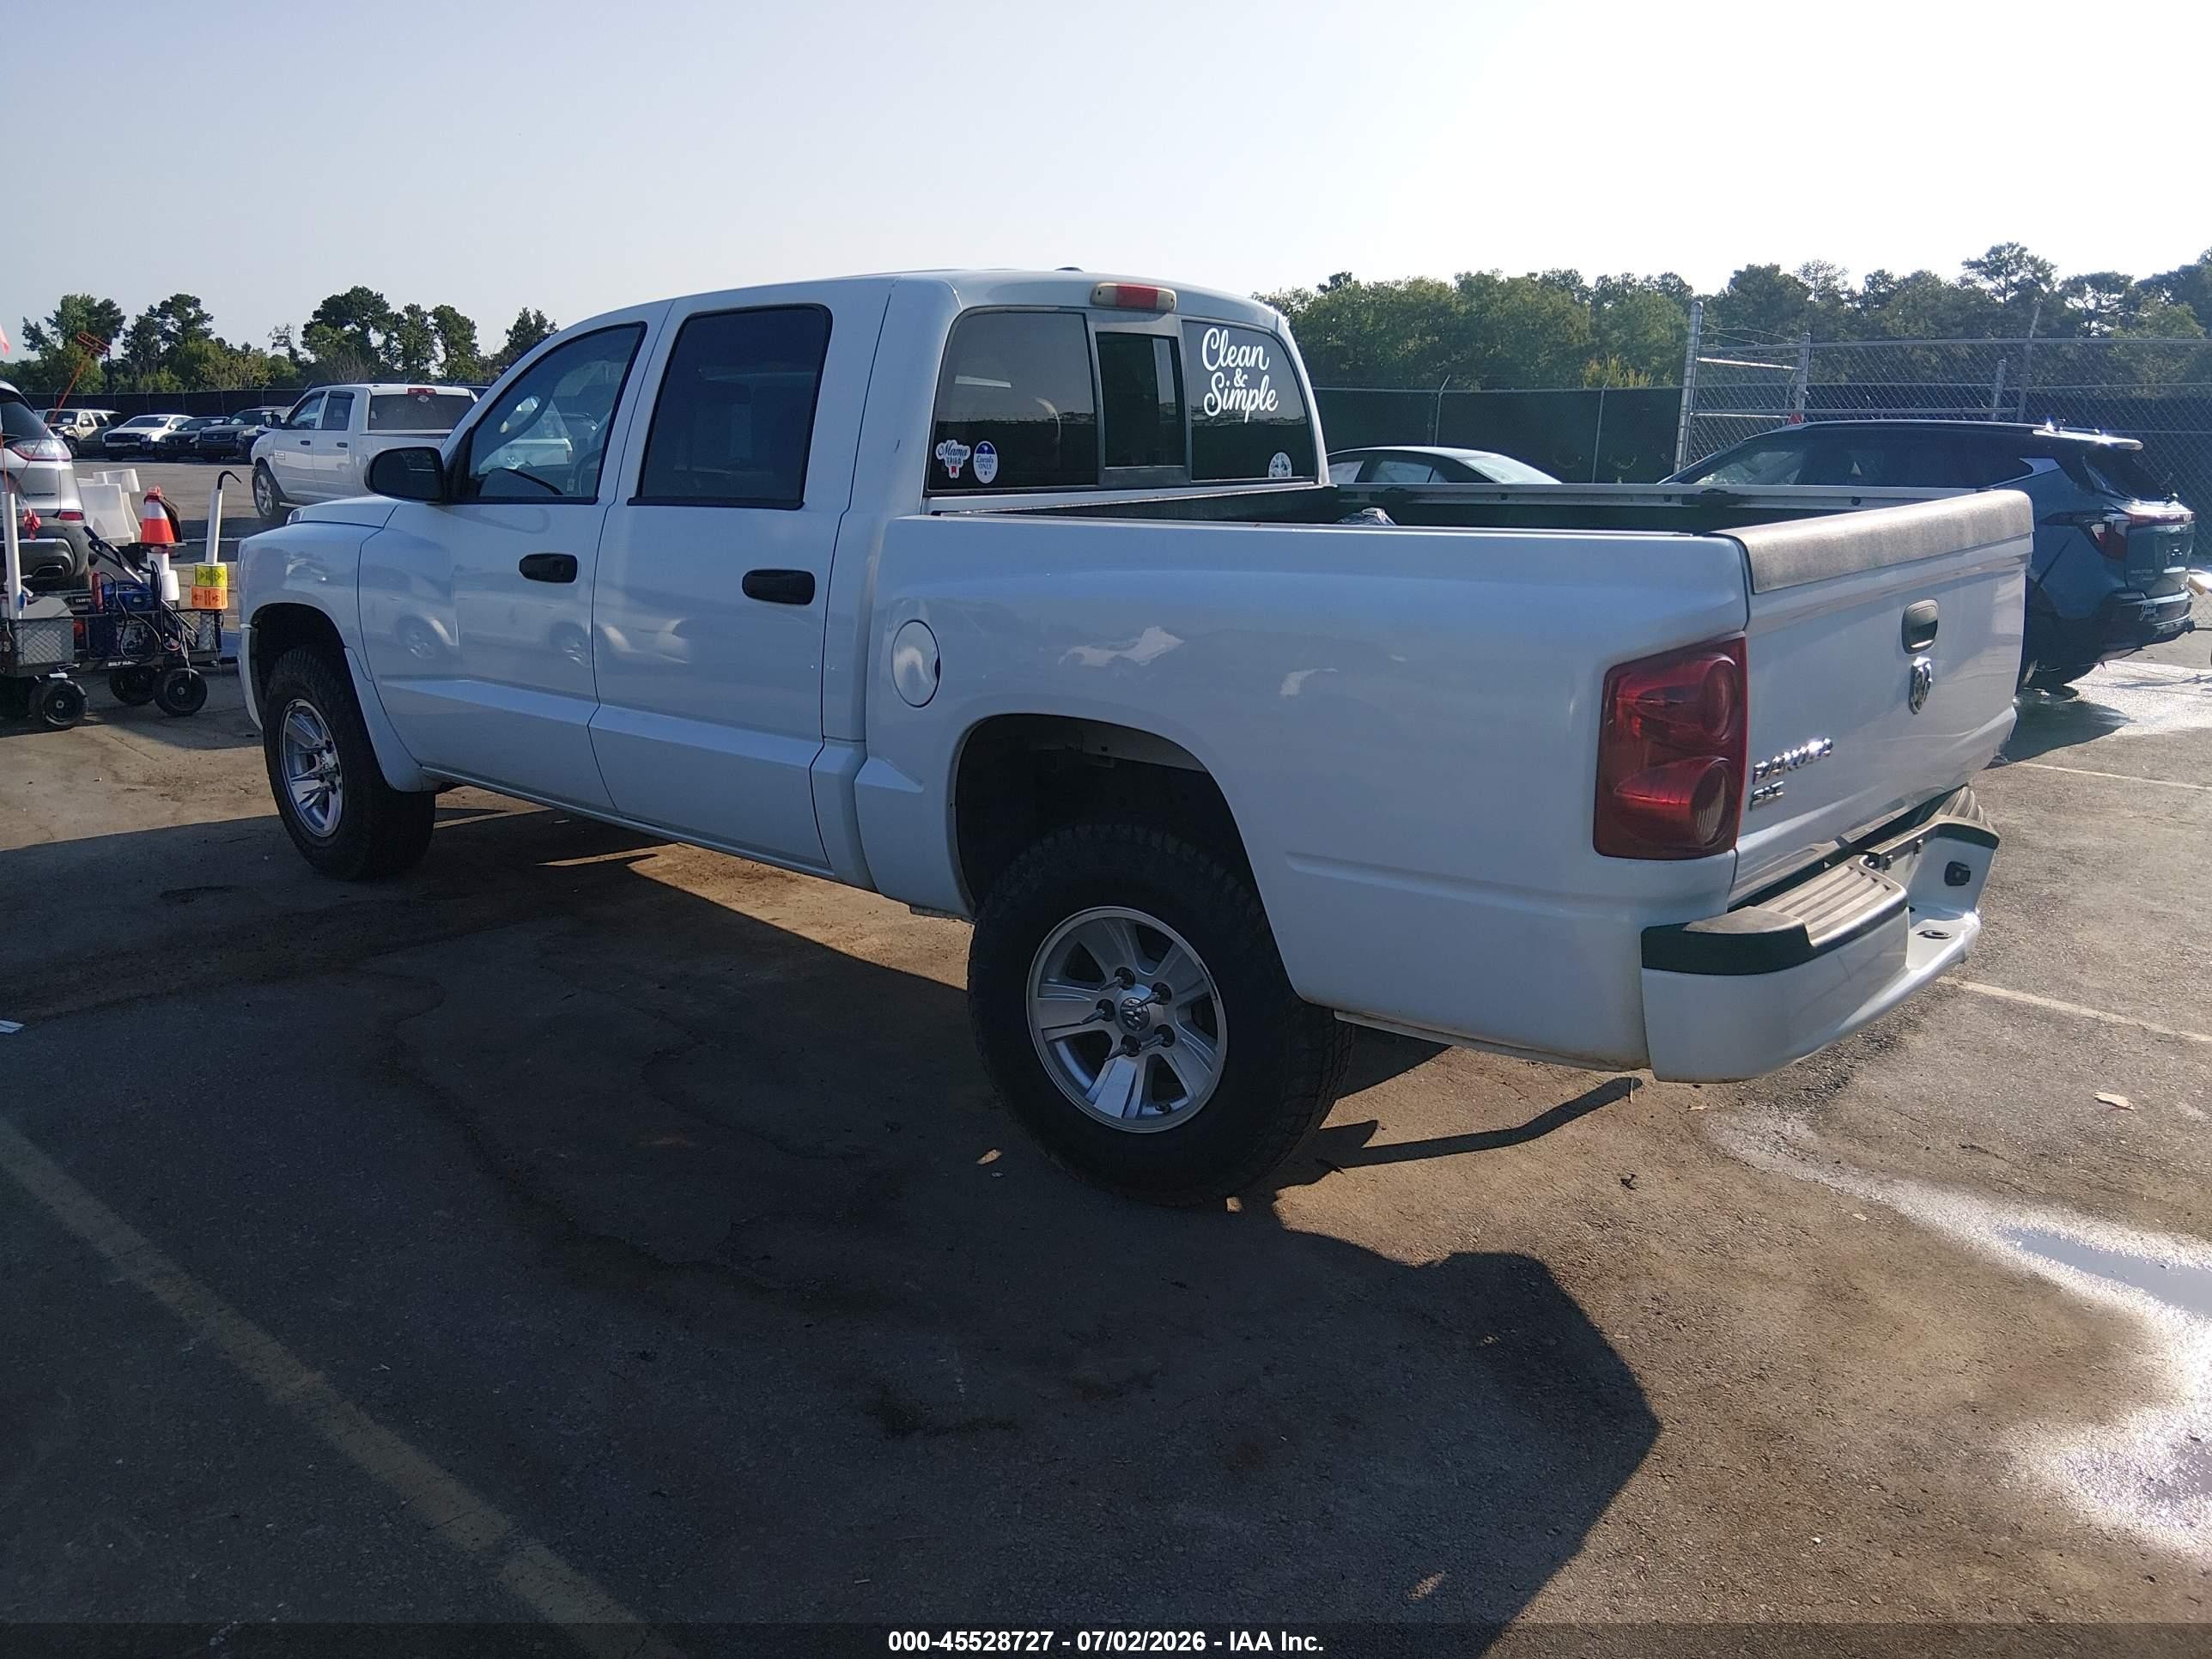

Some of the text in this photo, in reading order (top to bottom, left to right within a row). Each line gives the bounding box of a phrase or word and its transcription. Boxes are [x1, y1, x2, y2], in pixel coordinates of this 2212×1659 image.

[1202, 327, 1269, 371] Clean
[1233, 368, 1248, 387] &
[1204, 371, 1278, 423] Simple
[938, 441, 969, 457] Mama
